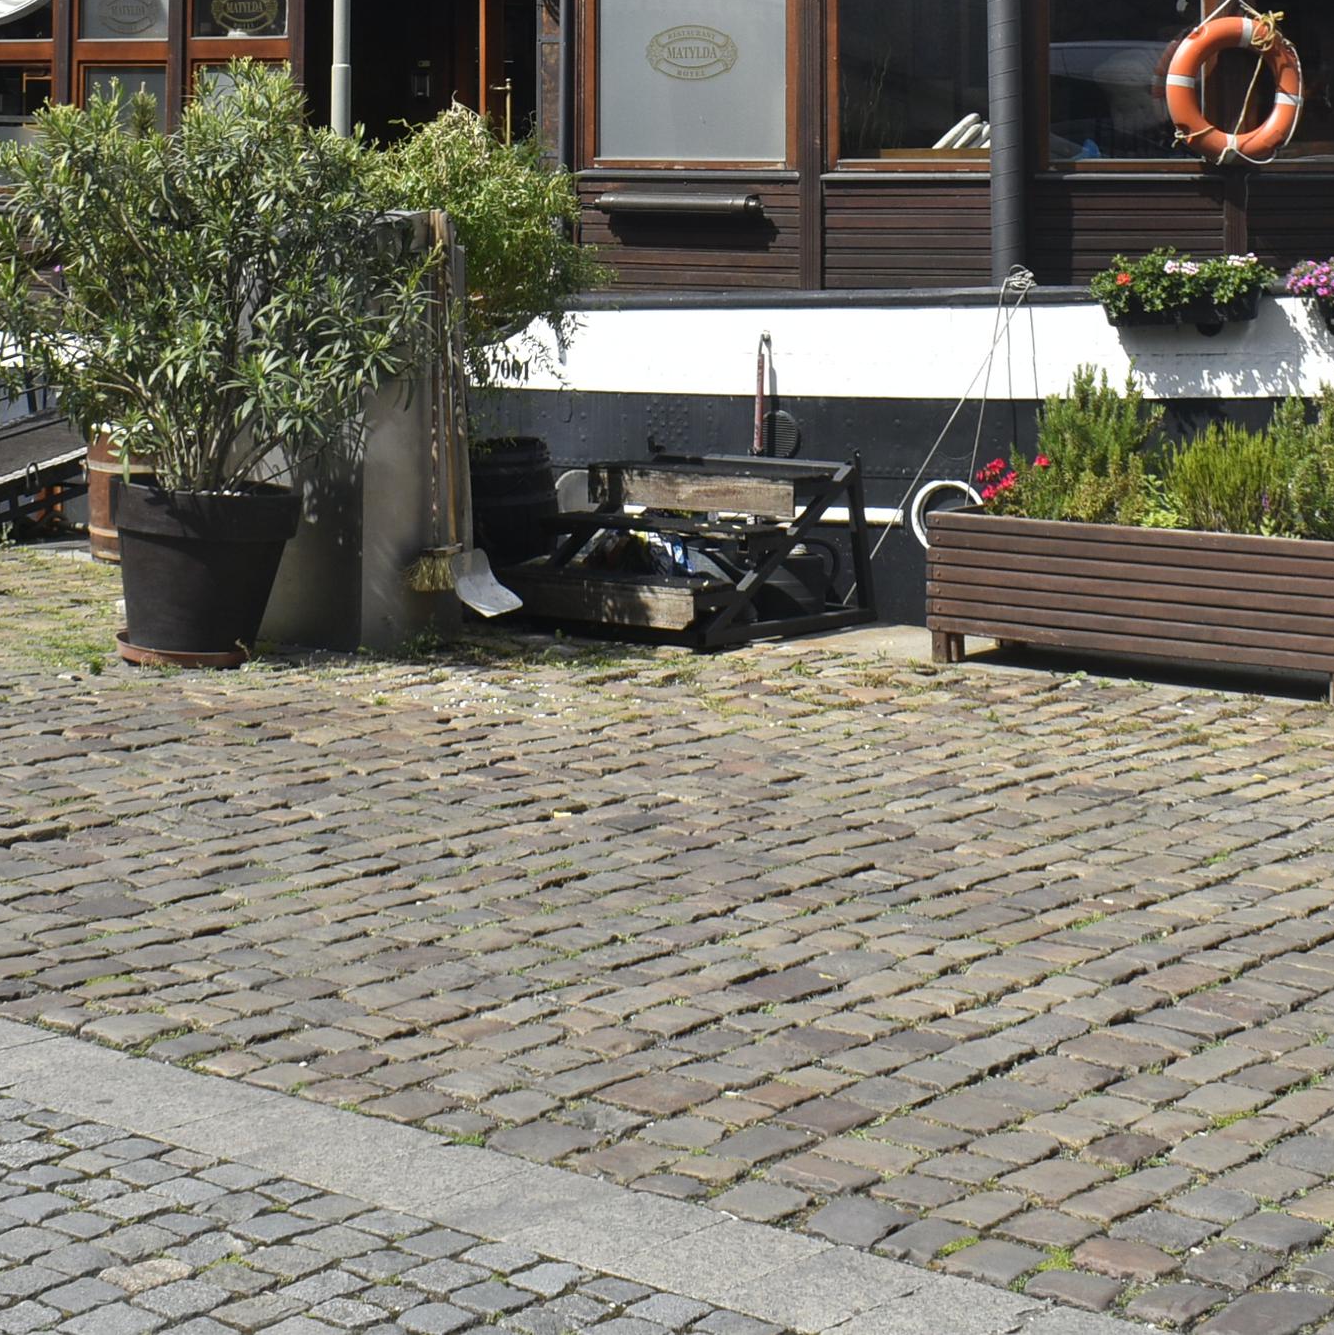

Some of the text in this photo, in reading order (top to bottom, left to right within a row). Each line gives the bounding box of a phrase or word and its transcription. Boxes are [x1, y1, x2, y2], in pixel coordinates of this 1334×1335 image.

[226, 1, 264, 14] MATYLDA
[667, 29, 715, 40] RESTAURANT
[667, 46, 717, 59] MATYLDA
